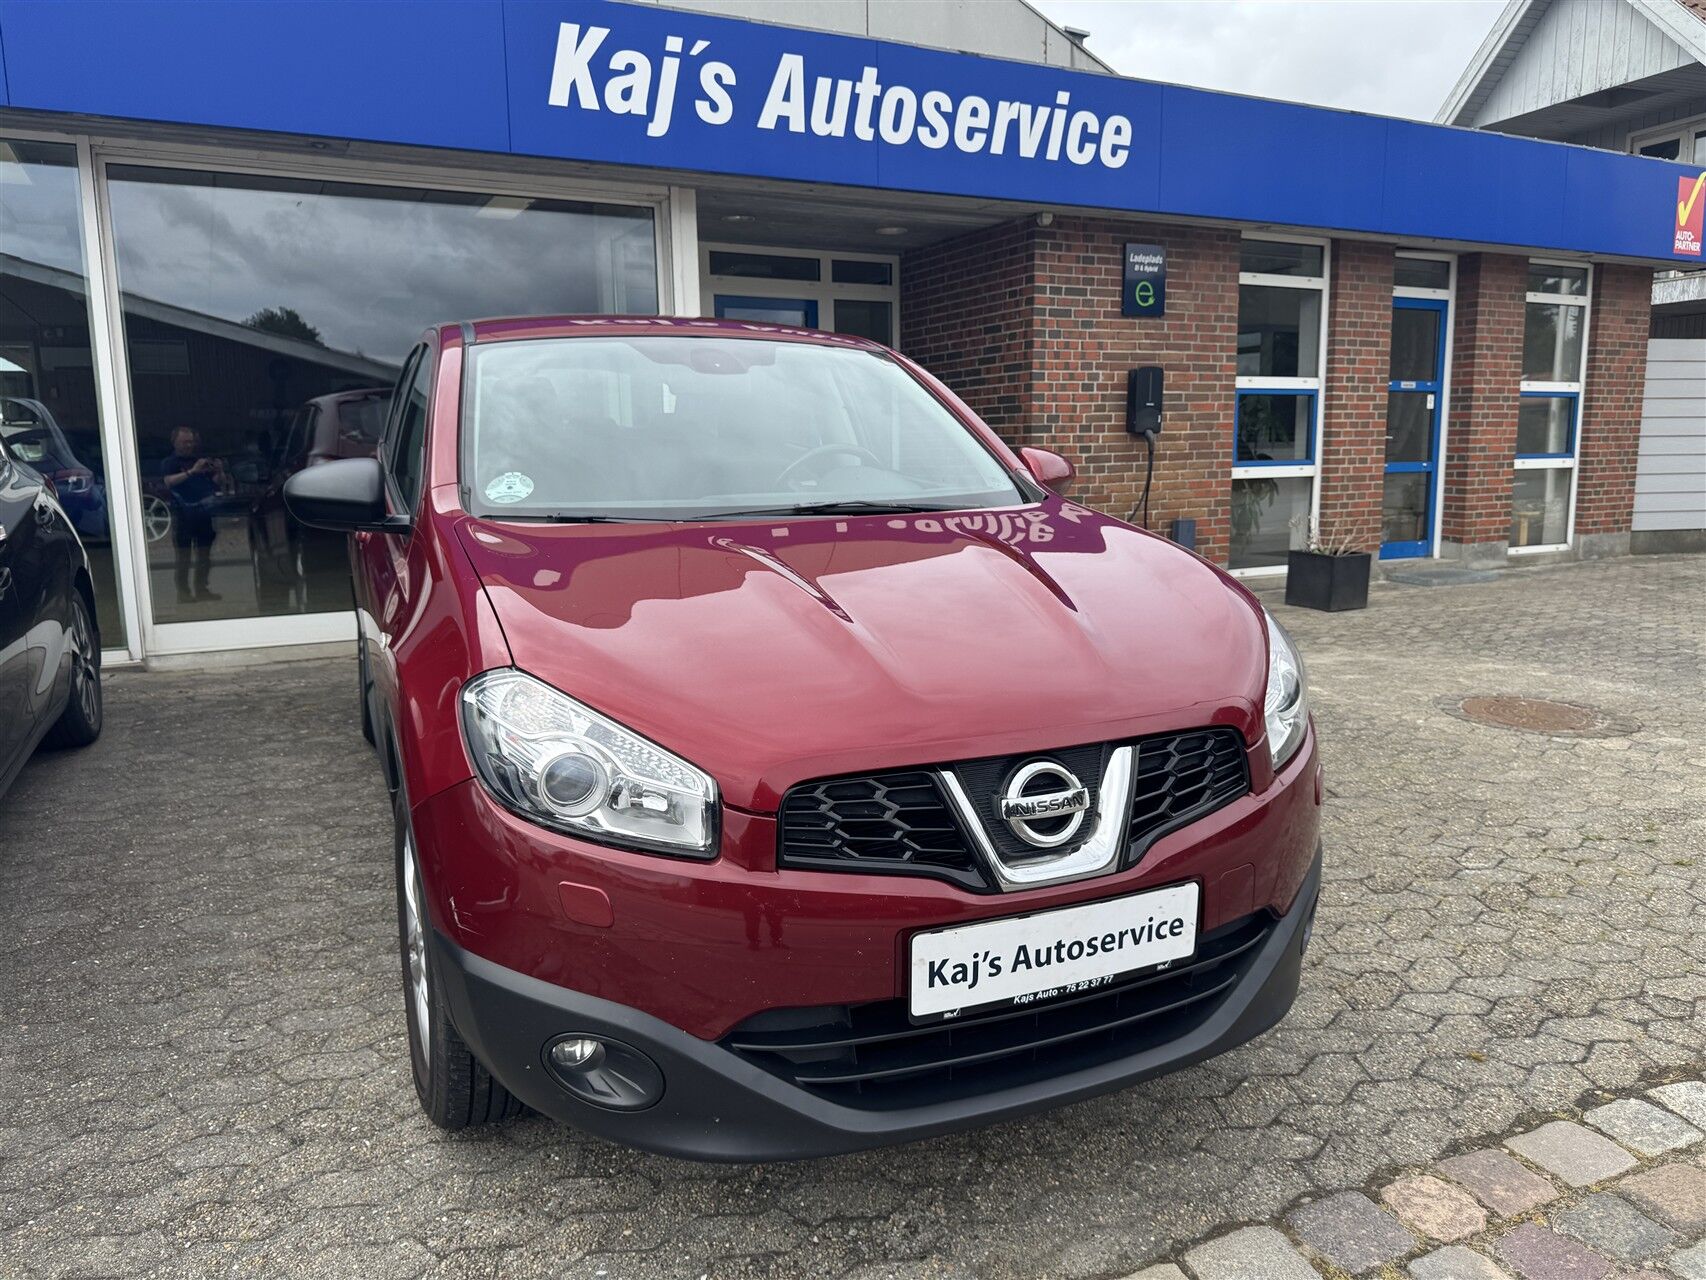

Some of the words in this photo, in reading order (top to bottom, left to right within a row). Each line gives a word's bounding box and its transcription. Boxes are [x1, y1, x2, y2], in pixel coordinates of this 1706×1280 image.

[757, 53, 1133, 168] Autoservice
[1674, 240, 1701, 252] PARTNER
[1675, 230, 1694, 241] AUTO-
[1130, 253, 1163, 264] Ladeplads
[1010, 789, 1086, 817] NISSAN
[928, 950, 1002, 989] Kaj's
[1011, 916, 1184, 973] Autoservice
[1013, 993, 1034, 1004] Kajs
[1035, 988, 1058, 999] Auto
[1066, 983, 1077, 993] 75
[1078, 980, 1089, 990] 22
[1090, 977, 1102, 987] 37
[1103, 974, 1114, 984] 77
